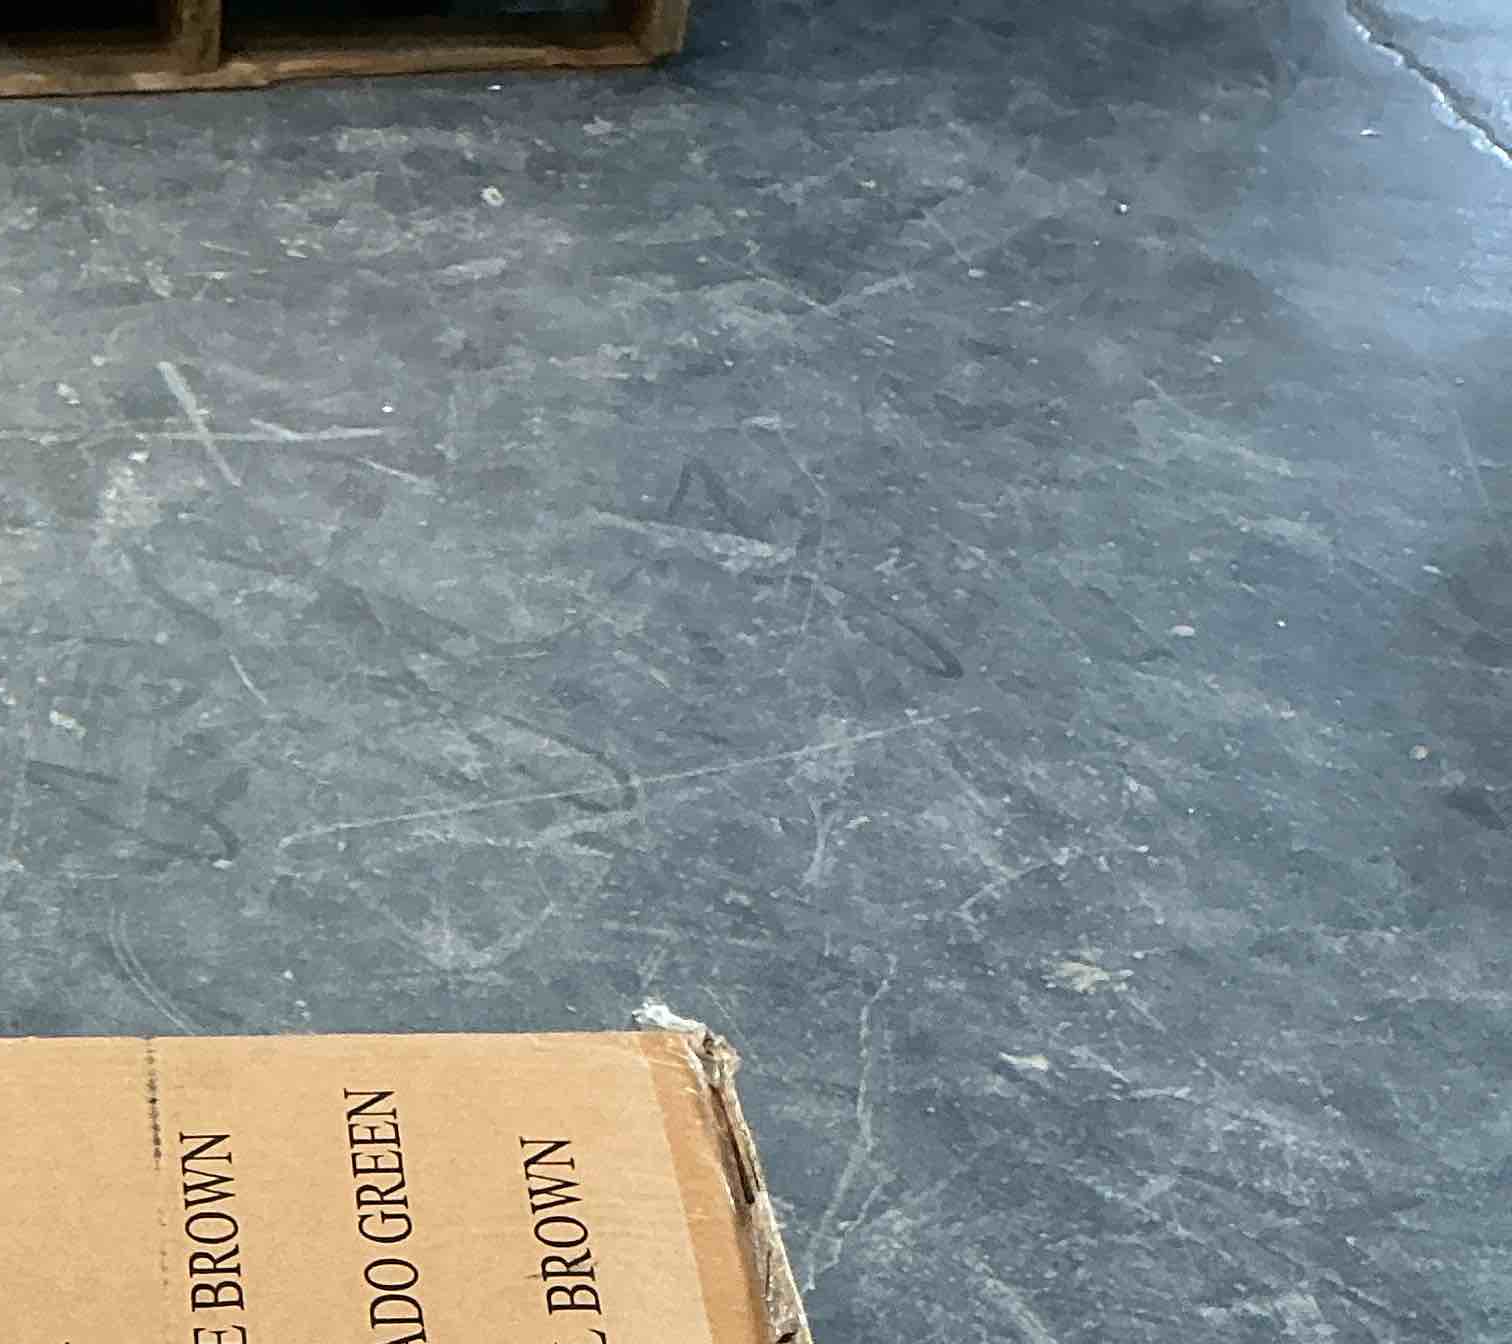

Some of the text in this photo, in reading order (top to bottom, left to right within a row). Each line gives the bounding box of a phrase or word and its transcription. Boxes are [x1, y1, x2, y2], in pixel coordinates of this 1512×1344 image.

[178, 1131, 246, 1313] BROWN
[343, 1087, 414, 1244] GREEN
[519, 1136, 603, 1316] BROWN
